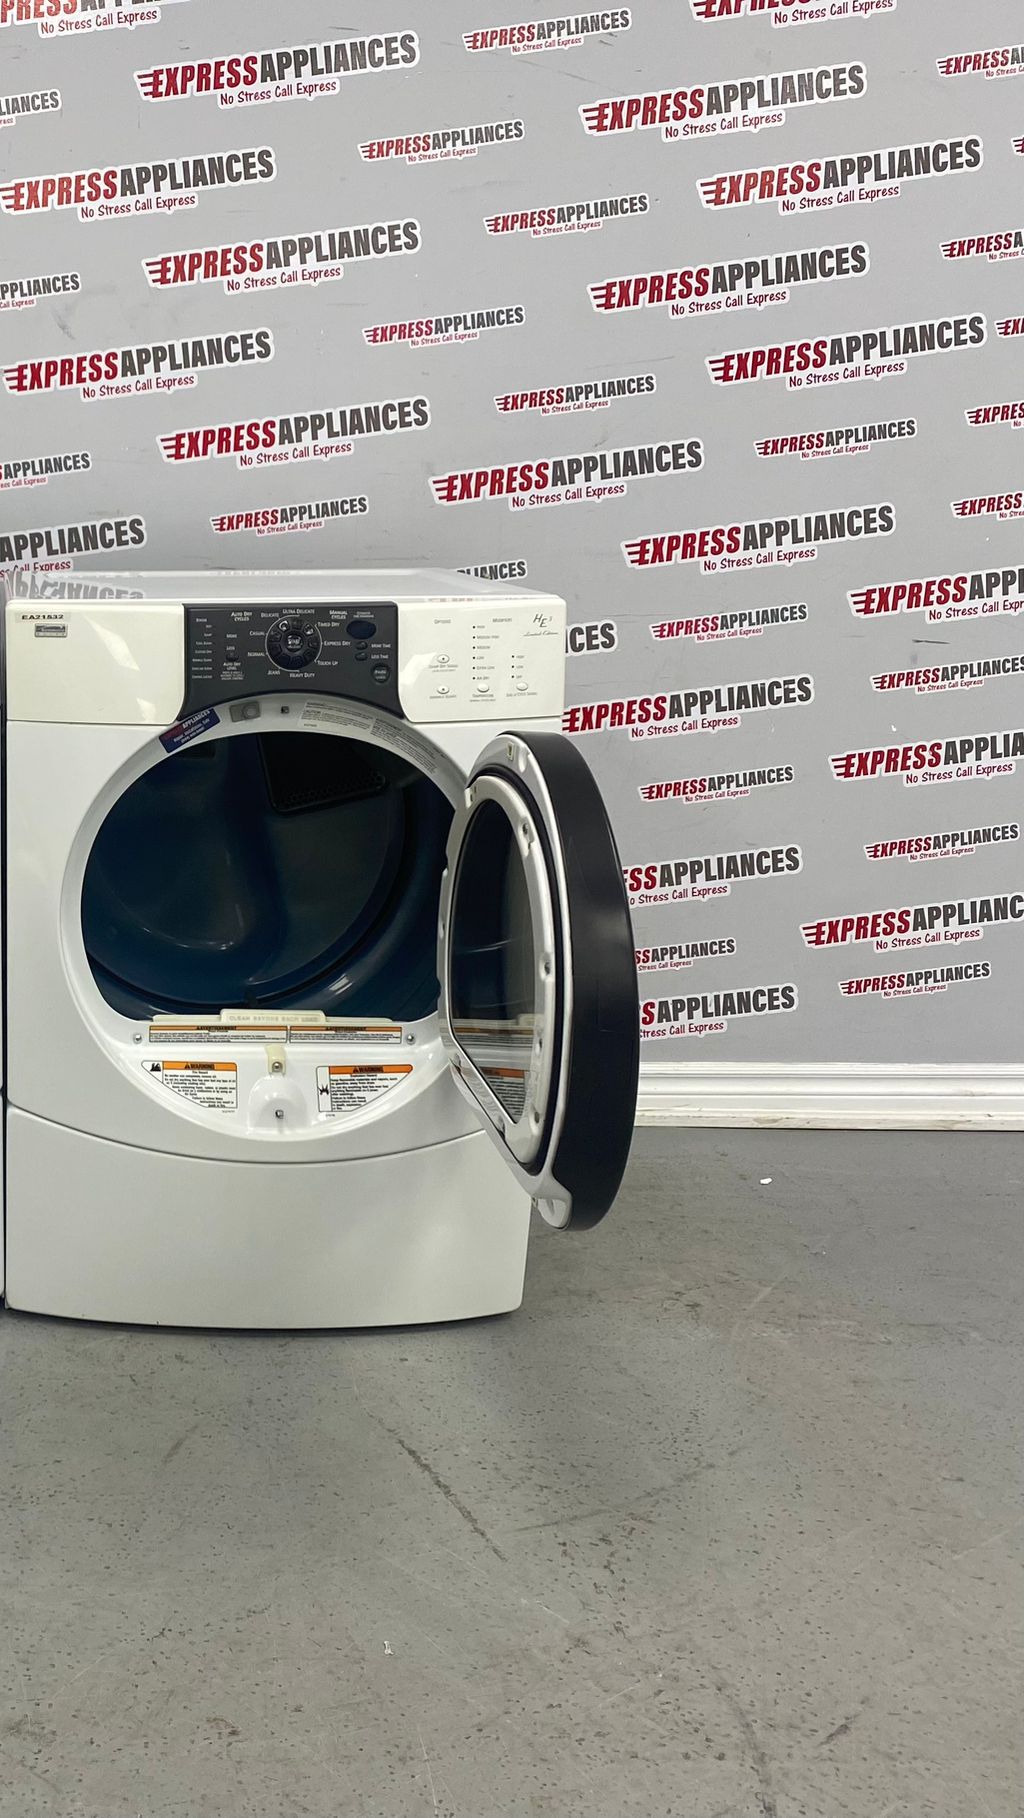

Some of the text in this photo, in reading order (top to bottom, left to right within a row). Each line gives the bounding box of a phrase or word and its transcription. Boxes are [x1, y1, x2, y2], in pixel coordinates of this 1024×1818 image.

[80, 194, 196, 220] No Stress Call Express
[788, 361, 905, 389] No Stress Call Express
[239, 442, 352, 468] No Stress Call Express
[631, 716, 739, 739] No Stress Call Express
[623, 847, 799, 892] SSAPPLIANCES
